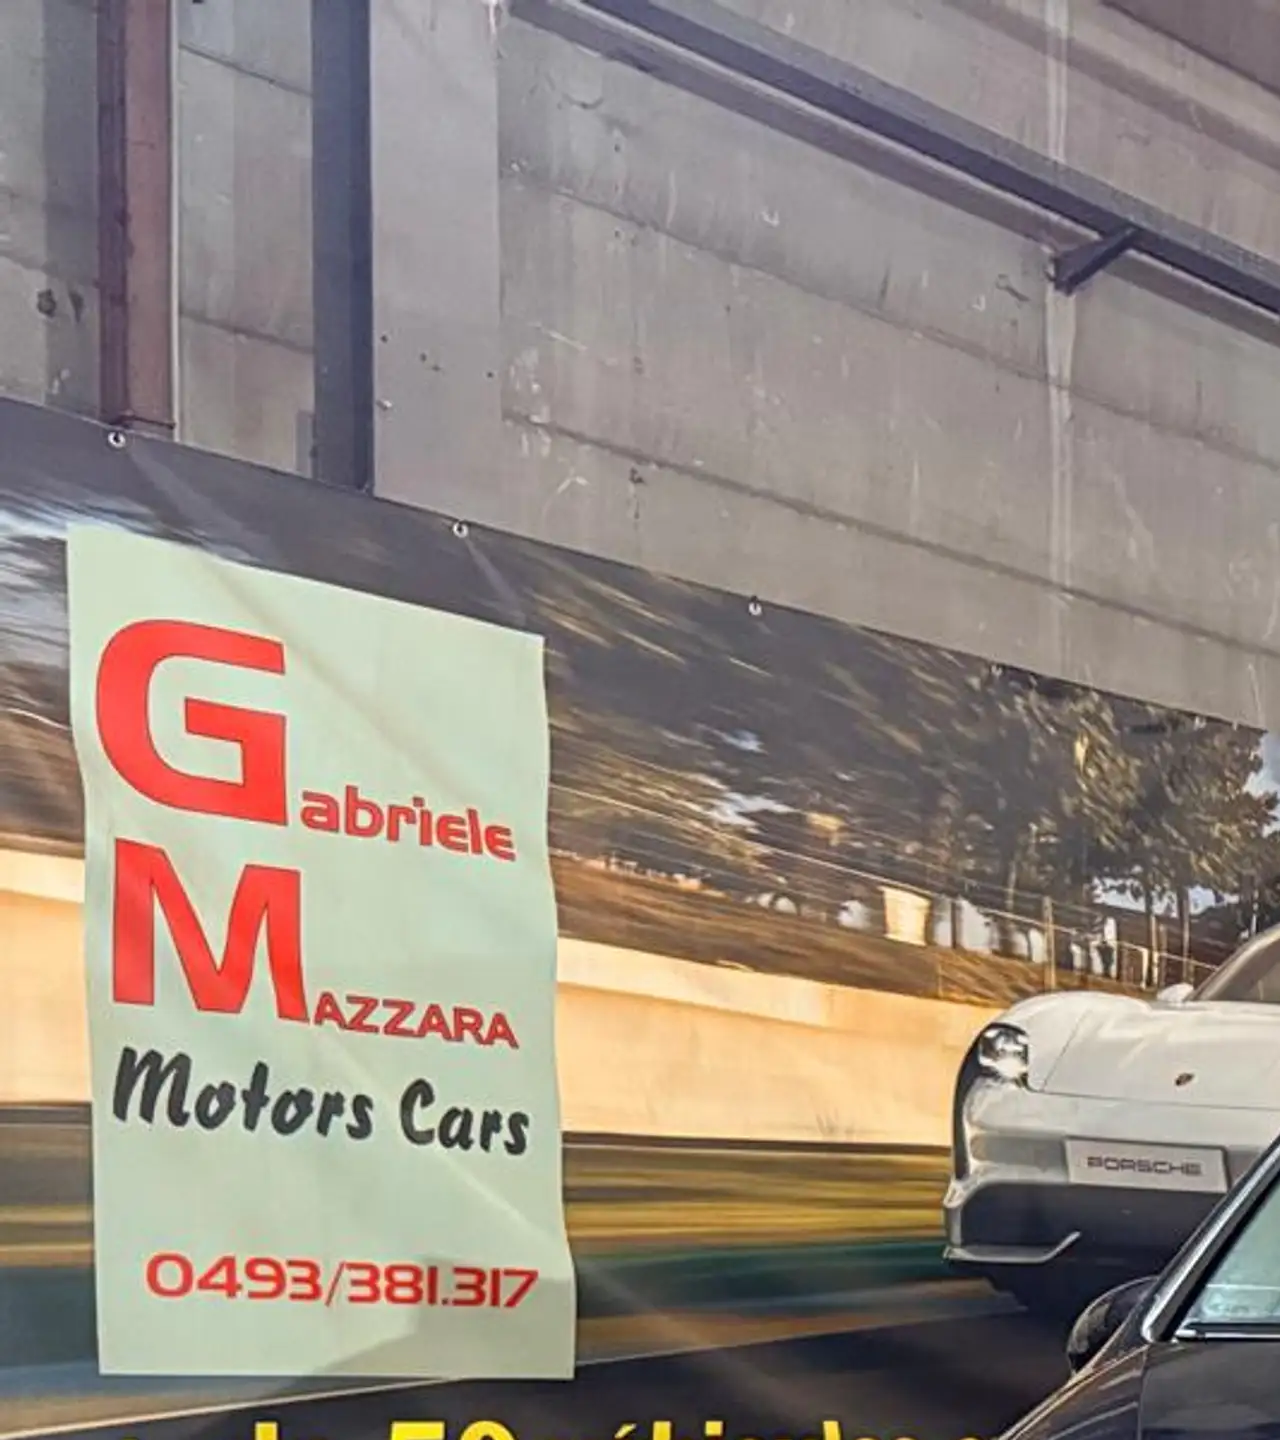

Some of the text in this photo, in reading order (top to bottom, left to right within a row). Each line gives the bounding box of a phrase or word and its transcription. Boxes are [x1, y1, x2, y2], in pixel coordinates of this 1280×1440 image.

[113, 1045, 530, 1157] Motors Cars
[1087, 1156, 1202, 1176] PORSCHE
[145, 1252, 538, 1309] 0493/381.317
